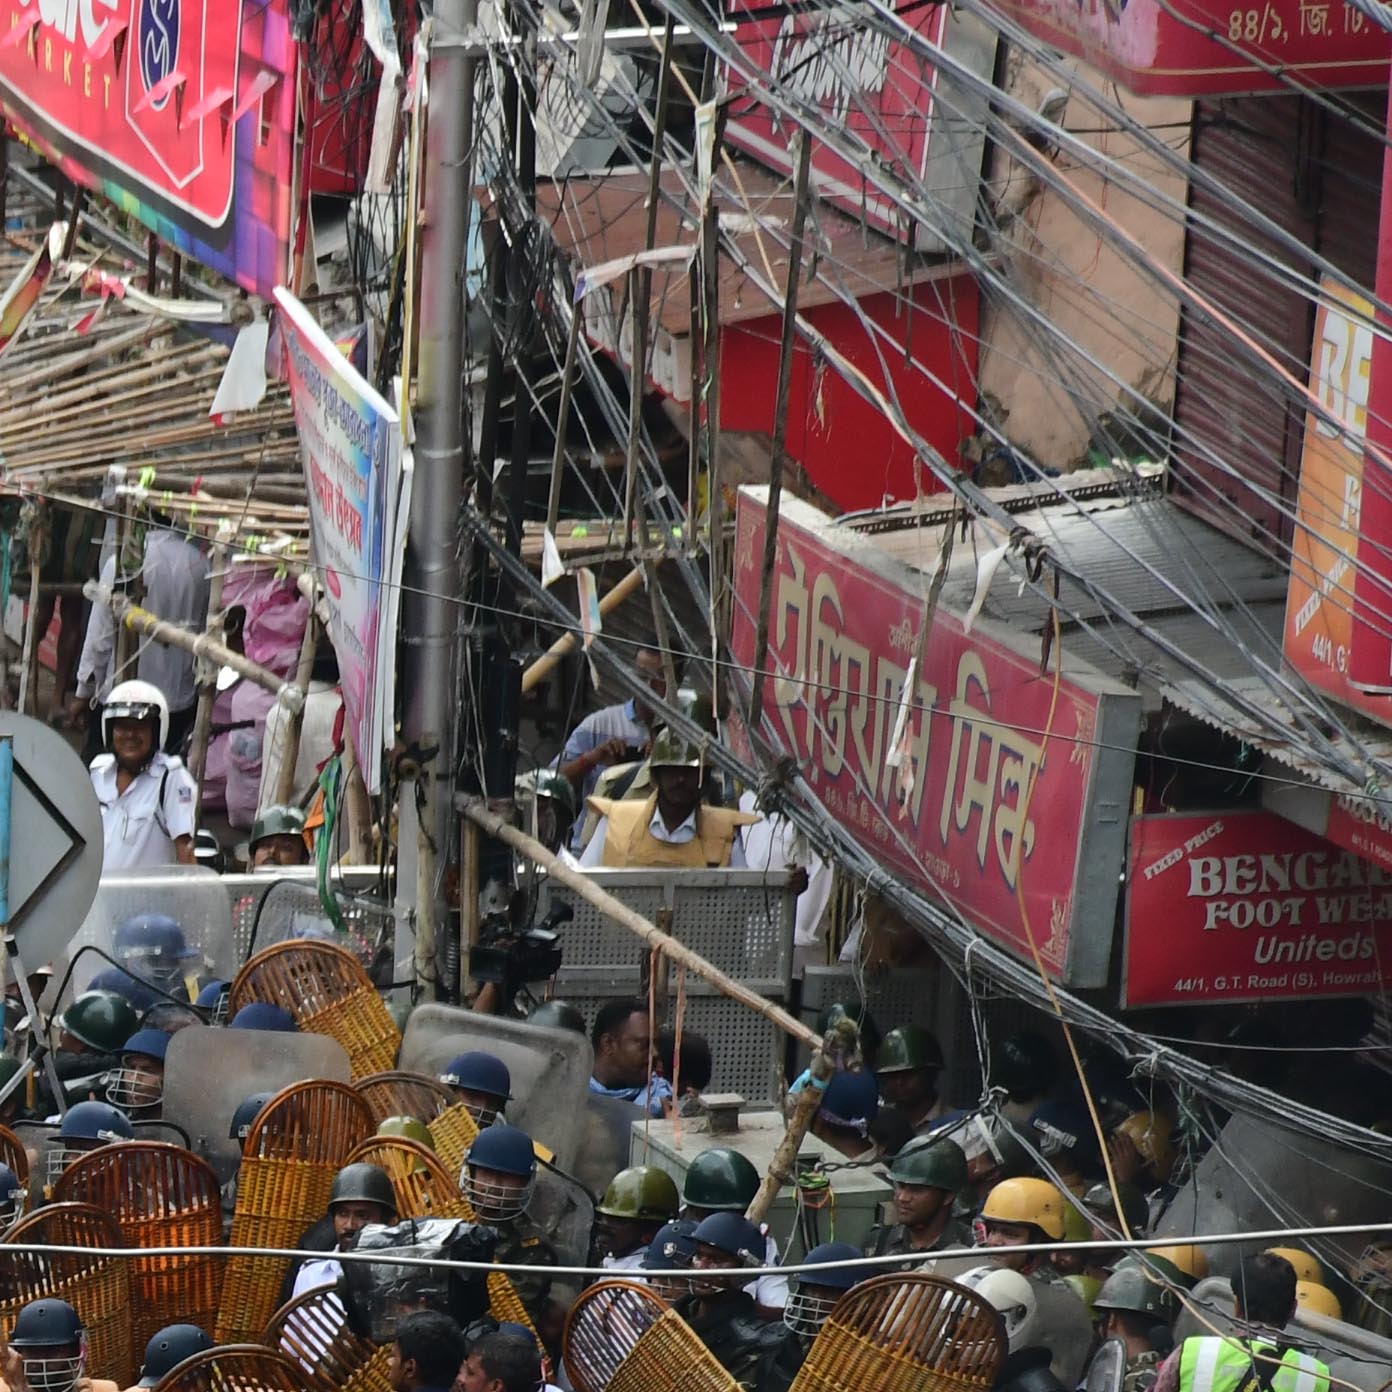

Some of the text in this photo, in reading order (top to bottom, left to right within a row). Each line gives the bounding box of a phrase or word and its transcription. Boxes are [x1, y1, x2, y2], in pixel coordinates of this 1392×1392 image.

[1203, 897, 1306, 931] FOOT
[1173, 977, 1211, 993] 44/1,
[1214, 975, 1244, 991] G.T.
[1248, 972, 1288, 989] Road
